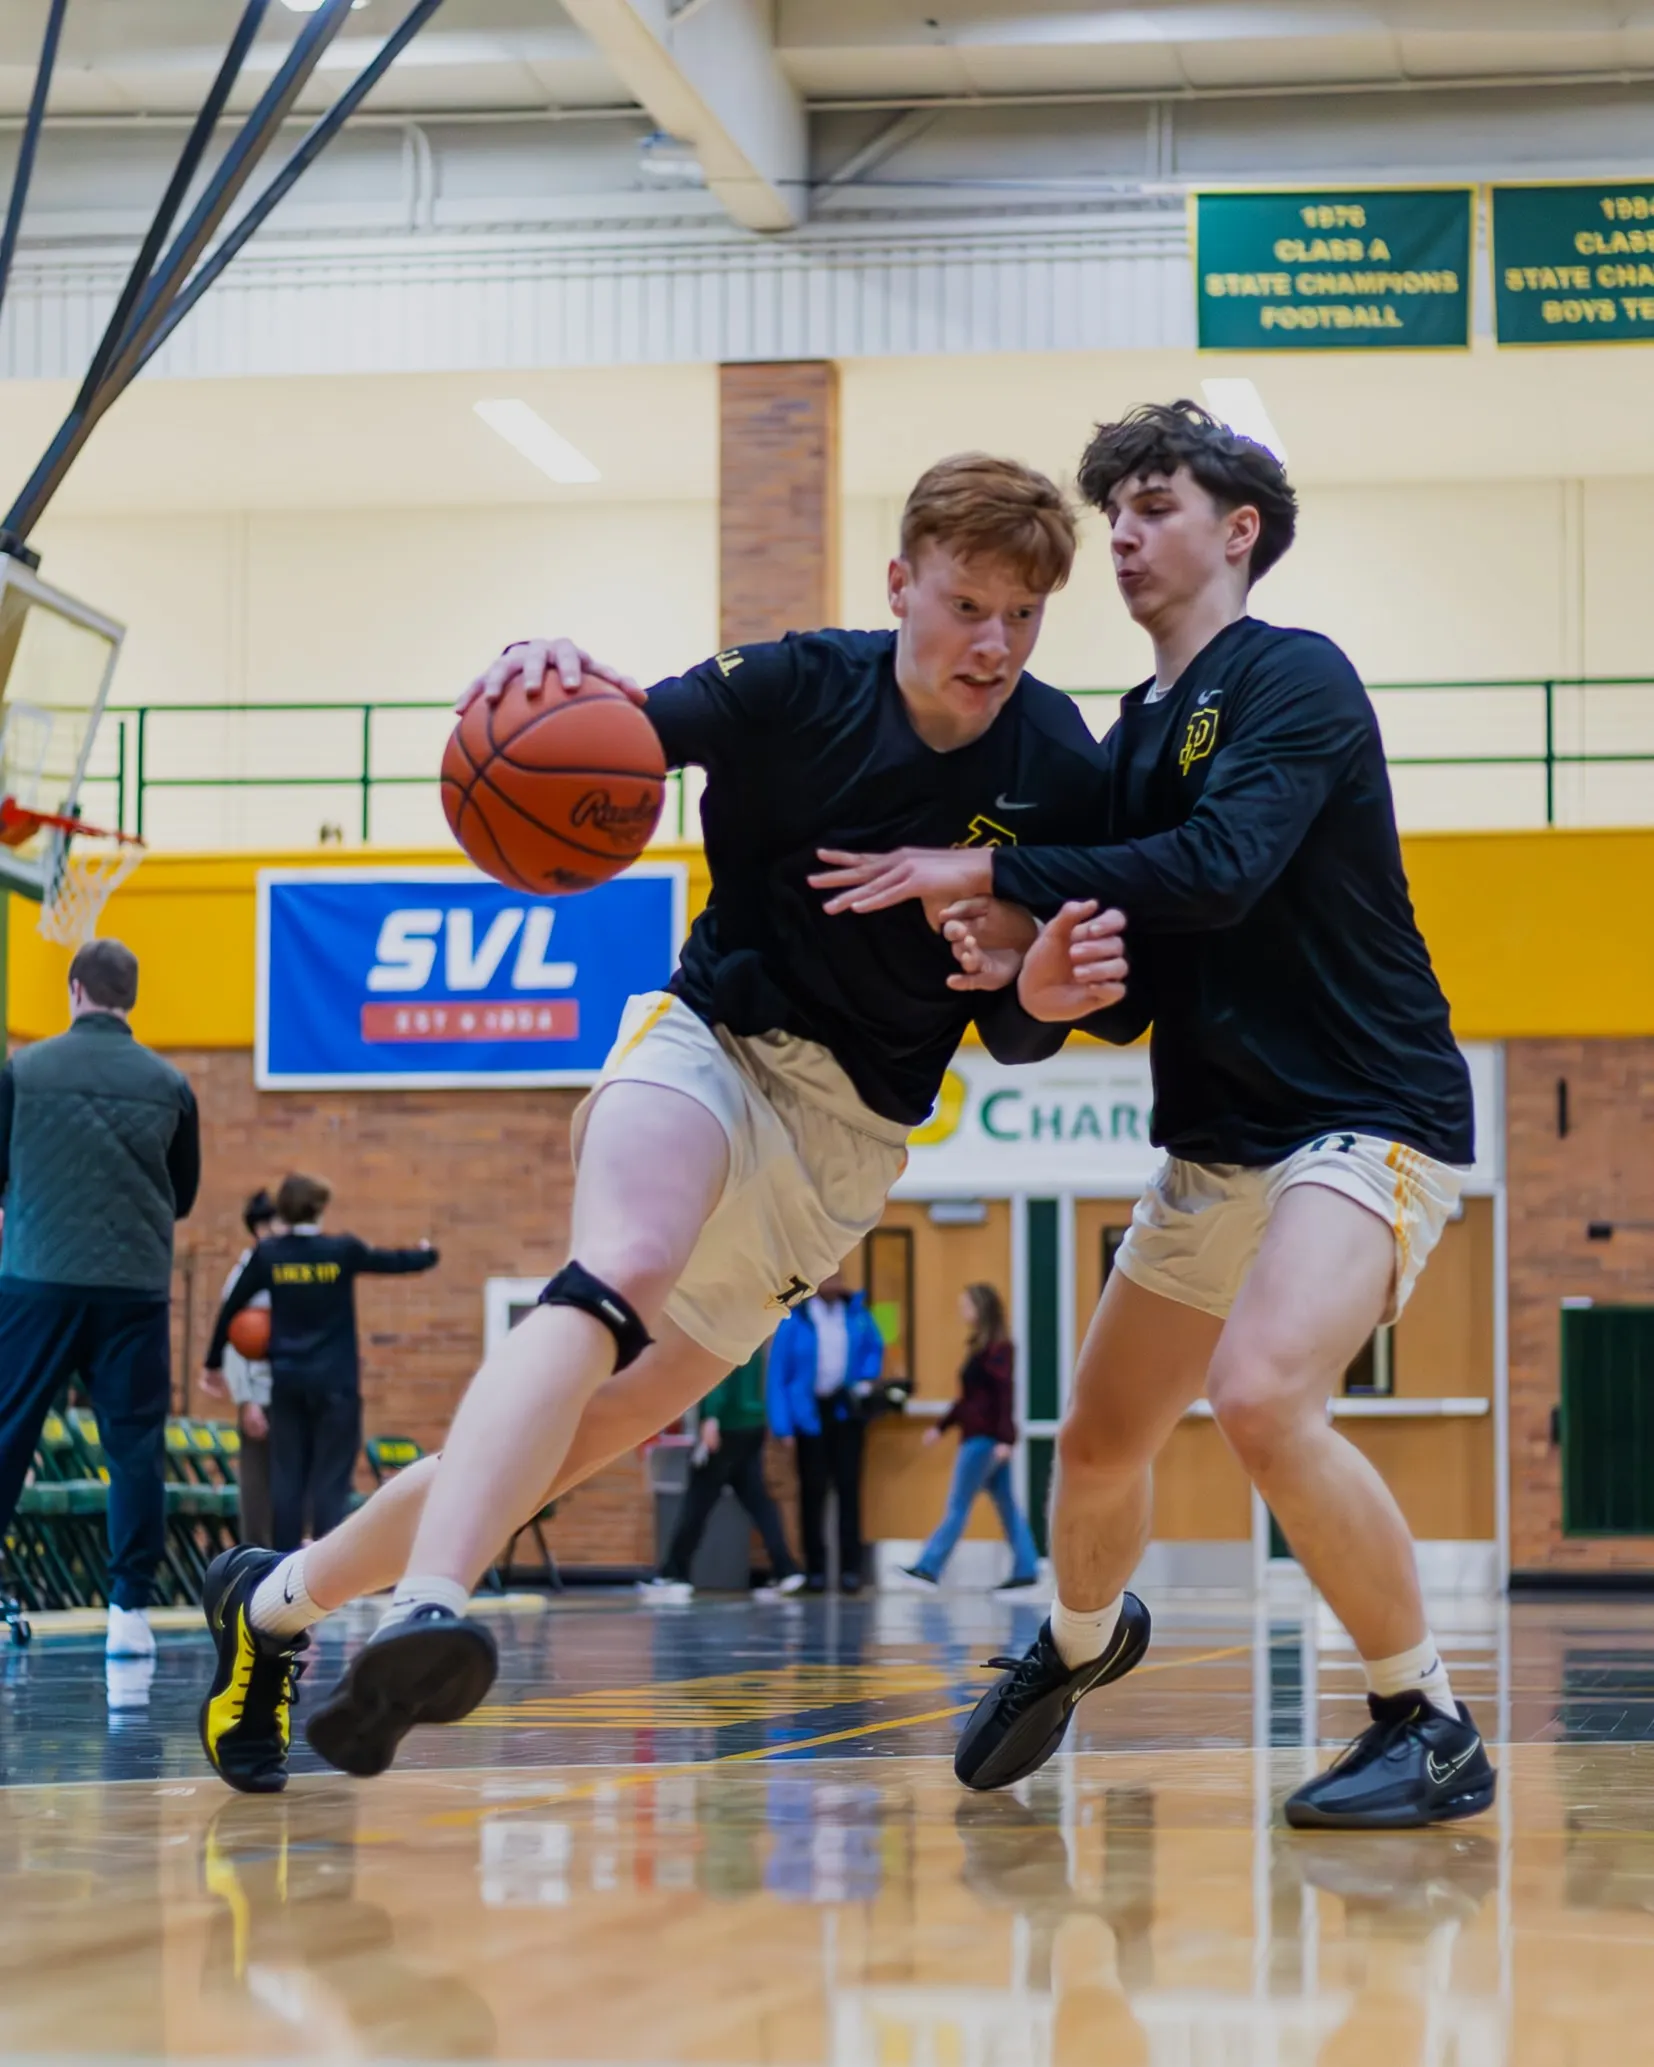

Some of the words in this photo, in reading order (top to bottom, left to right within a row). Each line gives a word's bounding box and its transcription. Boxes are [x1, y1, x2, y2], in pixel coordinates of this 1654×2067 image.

[1273, 238, 1364, 262] CLASS
[1368, 238, 1391, 261] A
[1204, 273, 1292, 296] STATE
[1295, 270, 1460, 295] CHAMPIONS
[1505, 267, 1591, 291] STATE
[1260, 305, 1404, 329] FOOTBALL
[1542, 299, 1617, 323] BOYS
[366, 907, 578, 991] SVL
